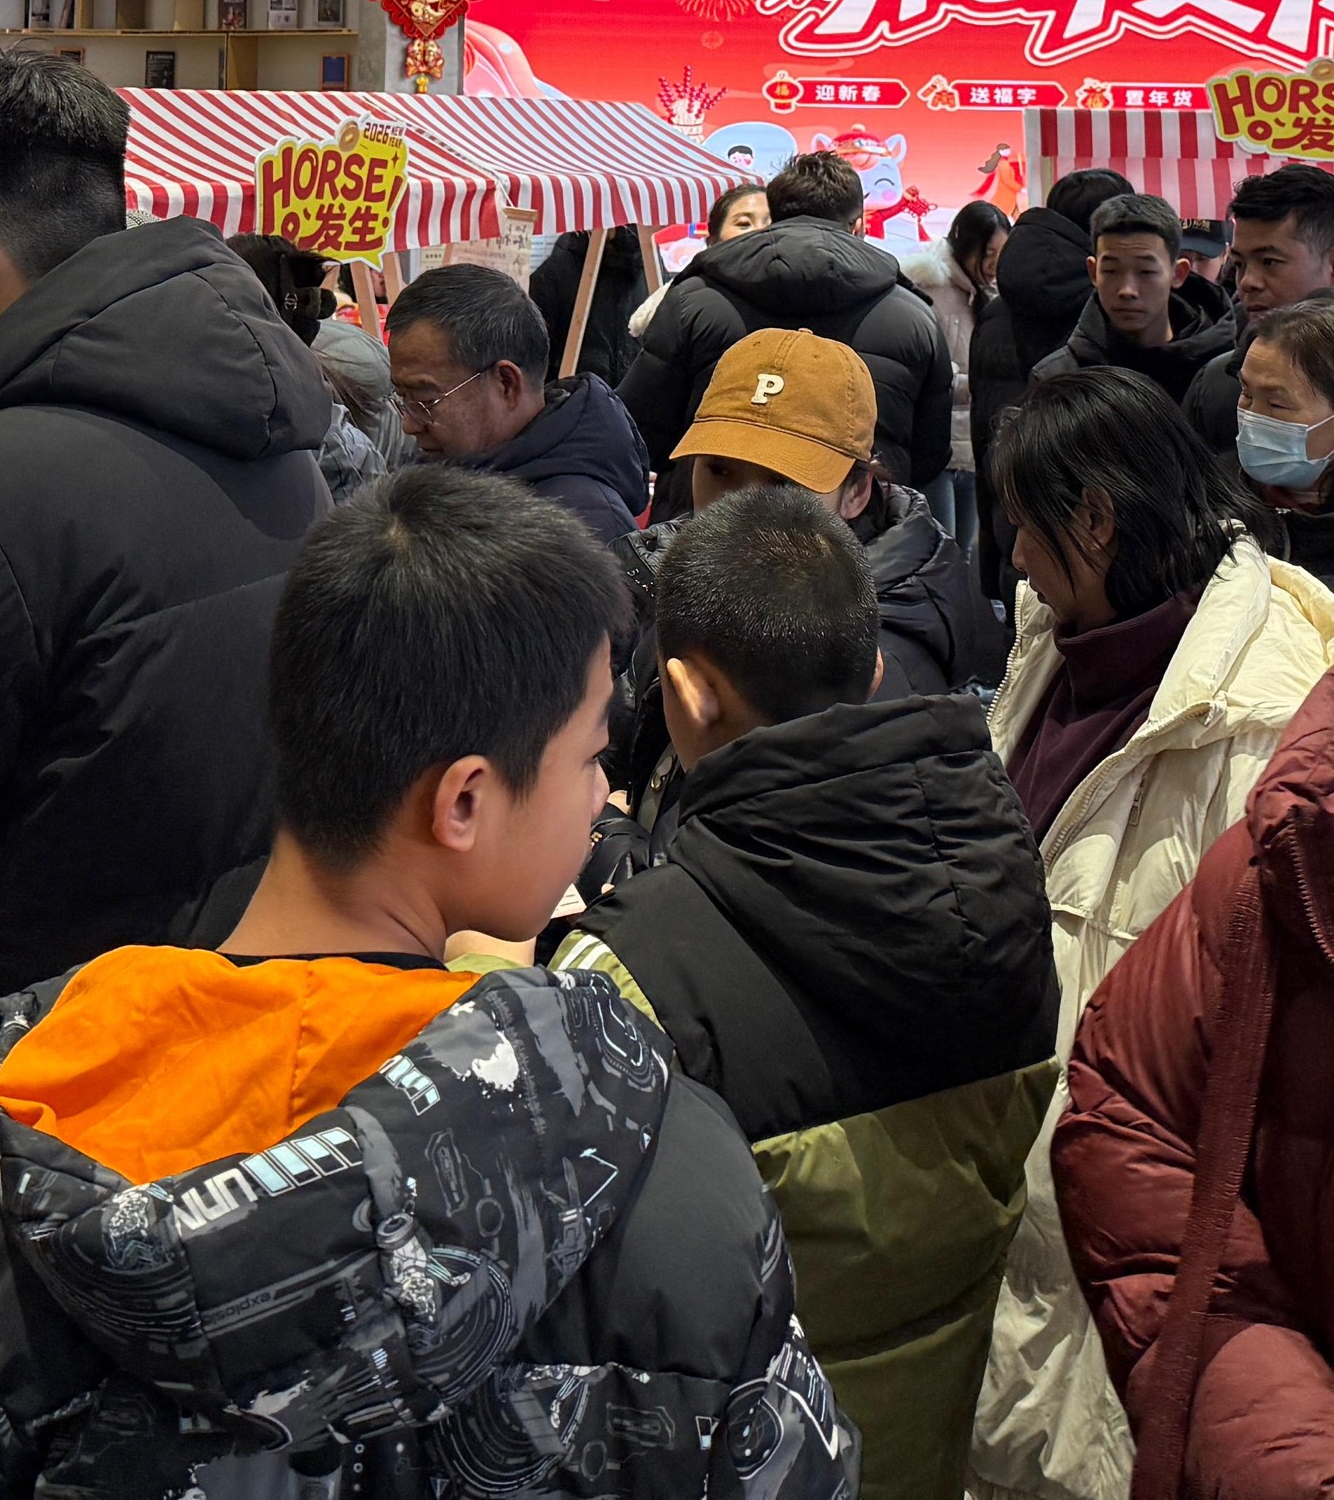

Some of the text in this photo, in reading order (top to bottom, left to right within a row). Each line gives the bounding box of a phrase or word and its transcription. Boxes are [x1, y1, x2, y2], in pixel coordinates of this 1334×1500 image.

[815, 85, 881, 102] 迎新春
[970, 87, 1036, 104] 送福字
[1125, 90, 1192, 107] 置年货
[364, 122, 389, 145] 2026
[751, 374, 784, 404] P
